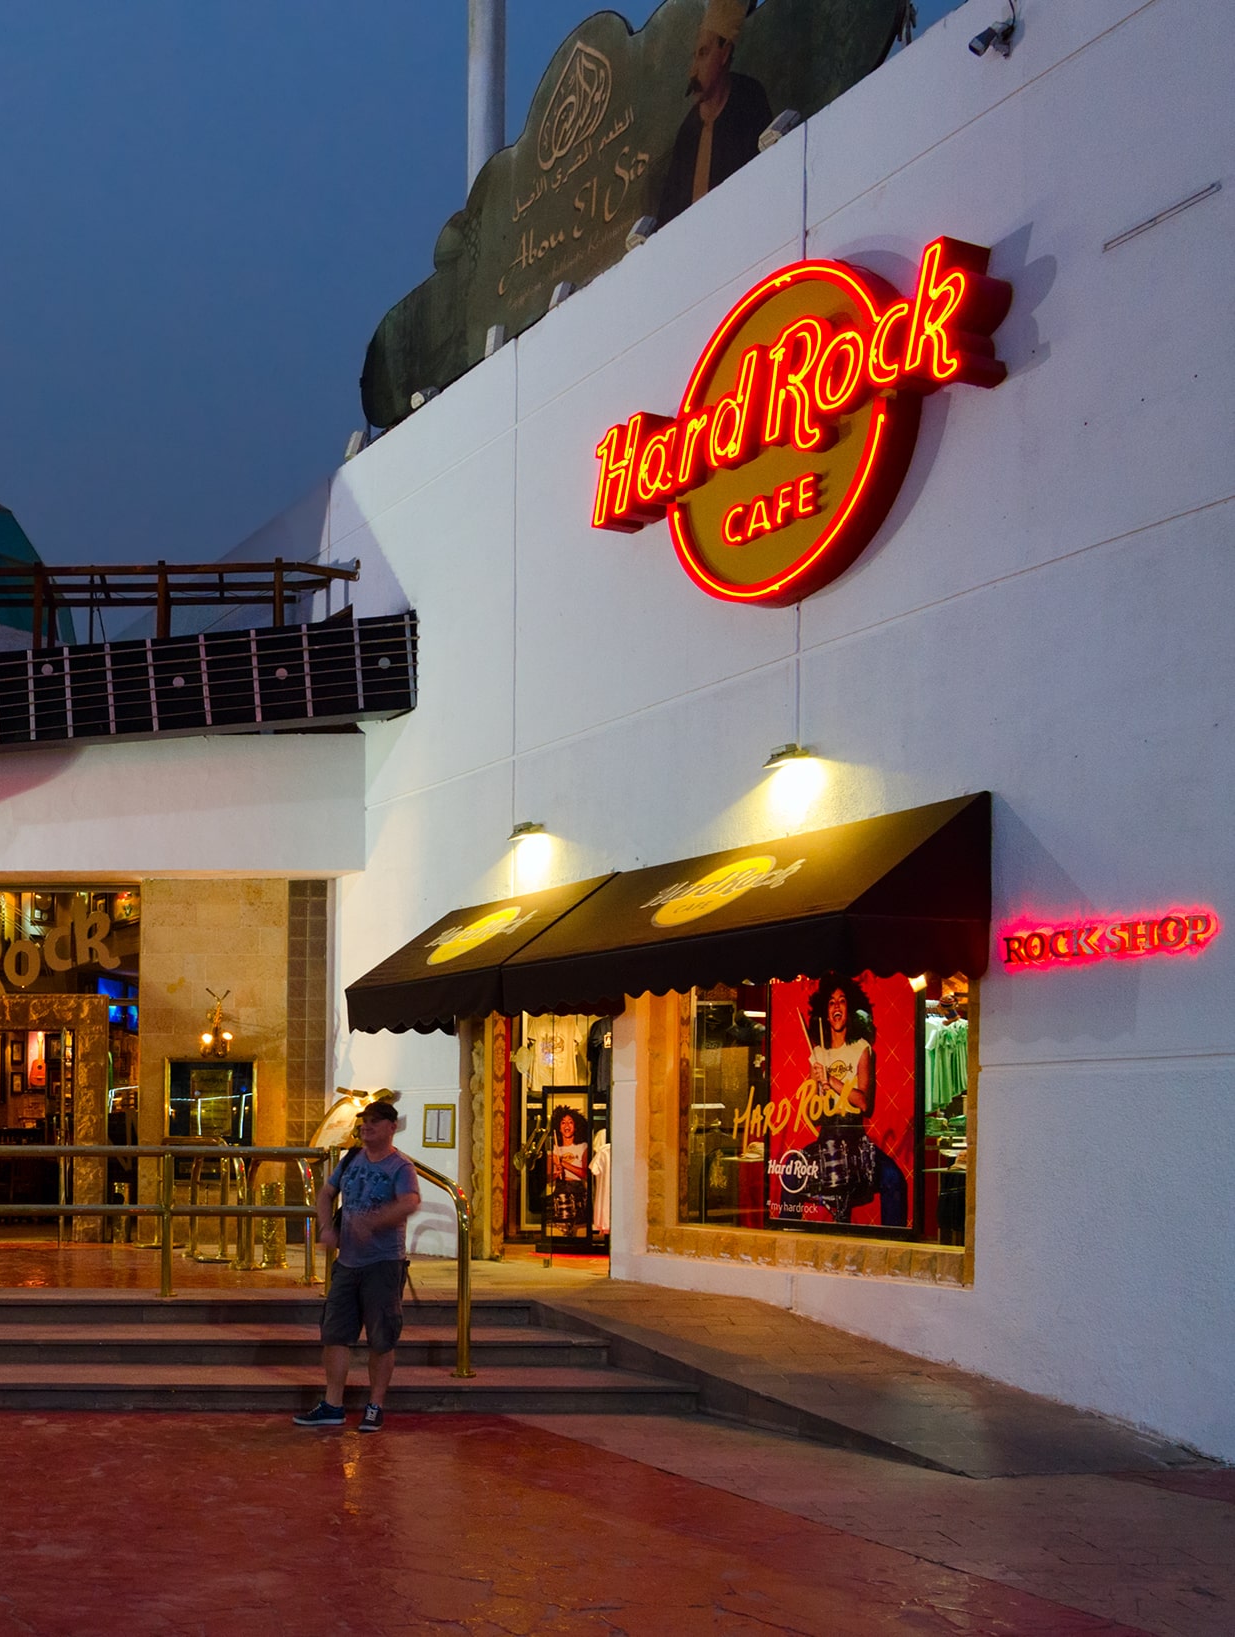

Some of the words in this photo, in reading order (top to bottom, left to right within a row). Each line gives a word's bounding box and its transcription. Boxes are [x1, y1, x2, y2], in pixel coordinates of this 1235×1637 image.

[592, 344, 763, 529] Hard
[765, 236, 968, 452] Rock
[722, 472, 822, 546] CAFE
[672, 900, 713, 914] CAFE
[1003, 926, 1100, 964] ROCK
[1104, 914, 1208, 954] SHOP
[767, 1159, 794, 1176] Hard
[794, 1160, 819, 1179] Rock
